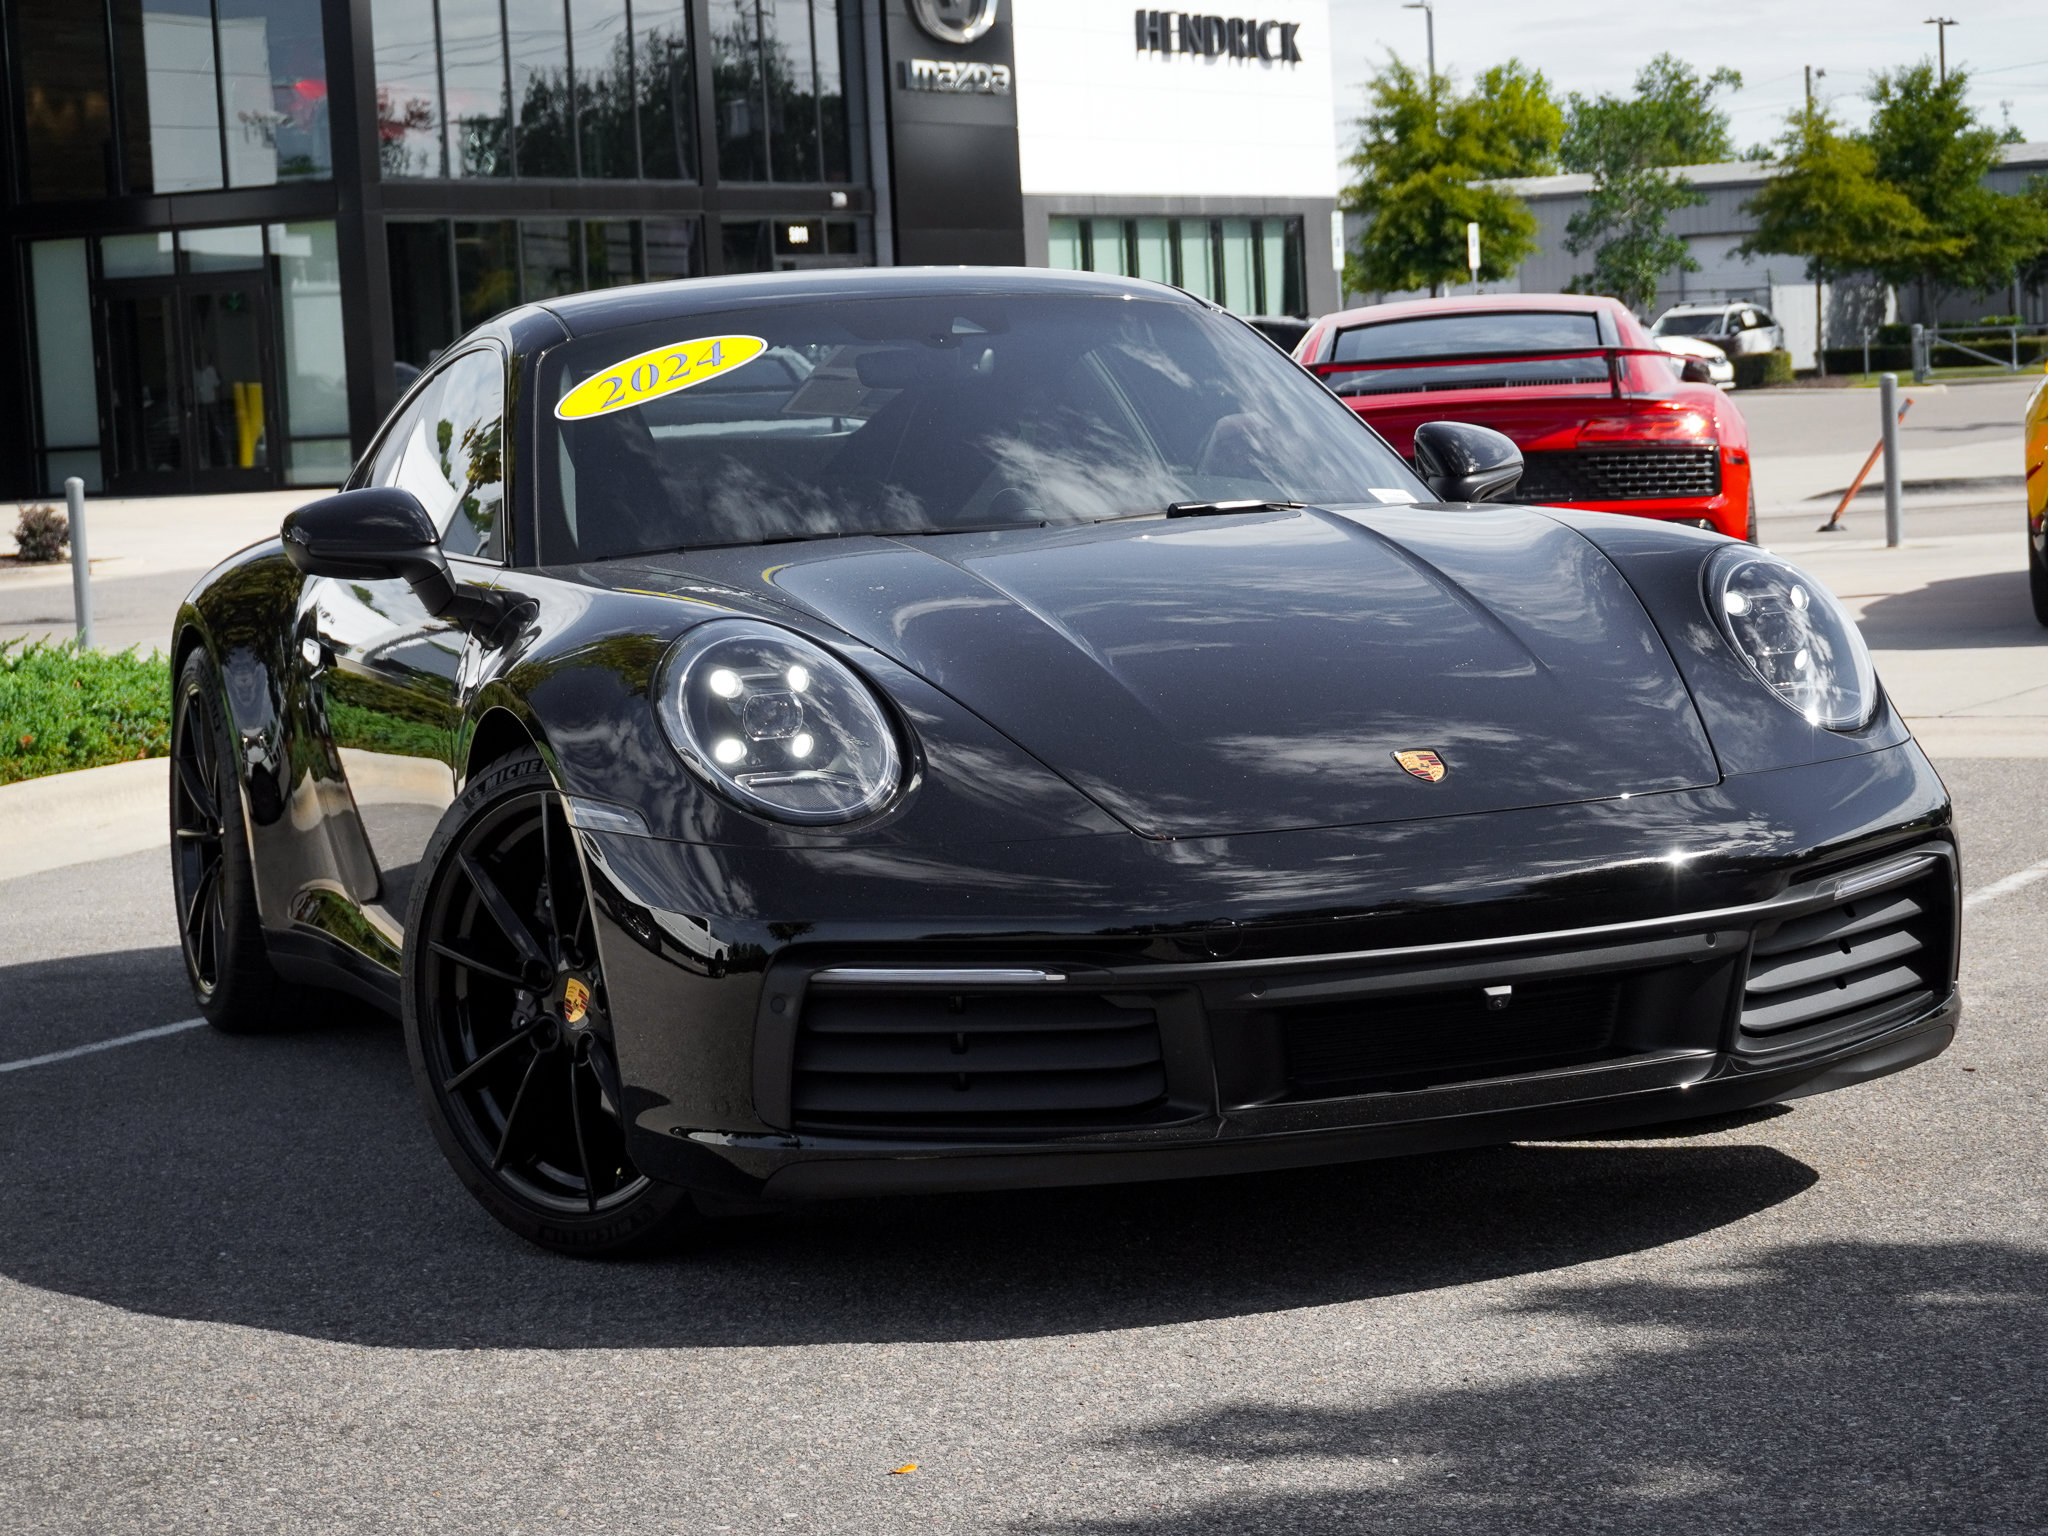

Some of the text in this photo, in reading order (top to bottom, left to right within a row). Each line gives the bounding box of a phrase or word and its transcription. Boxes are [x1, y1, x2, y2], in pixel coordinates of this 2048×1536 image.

[1136, 9, 1302, 62] HENDRICK
[598, 340, 725, 409] 2024
[484, 758, 549, 791] MICHEL
